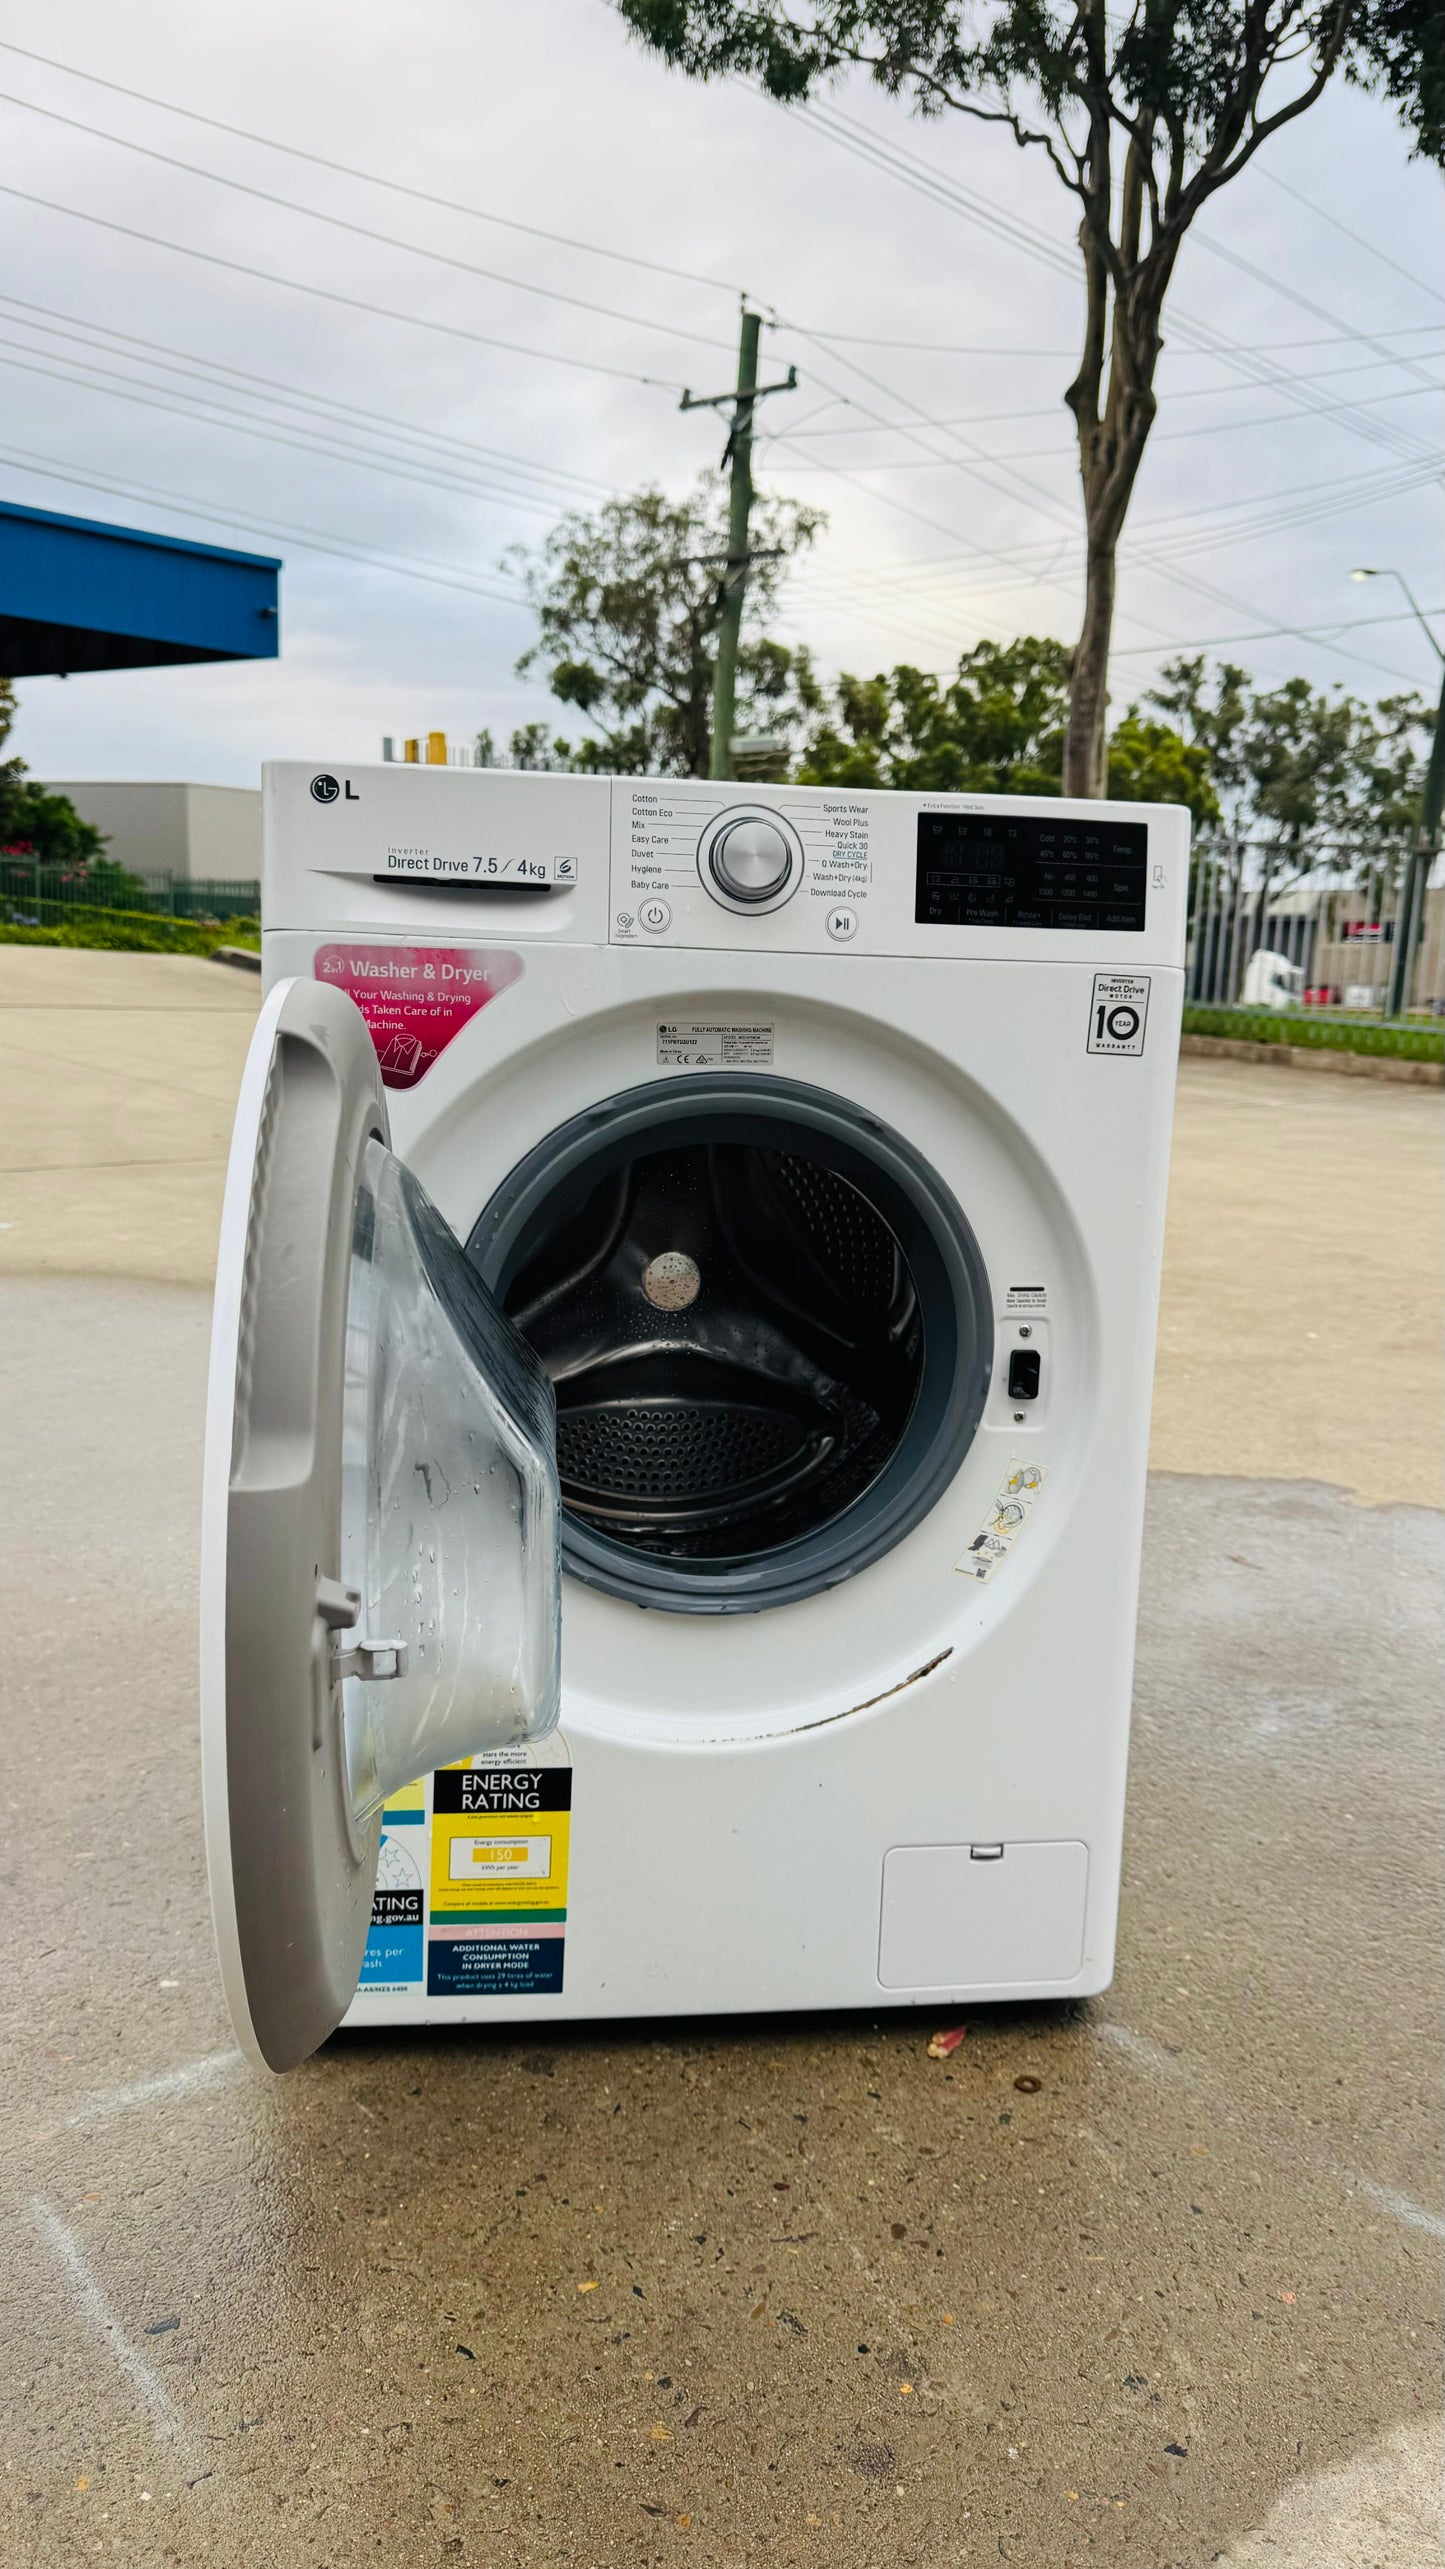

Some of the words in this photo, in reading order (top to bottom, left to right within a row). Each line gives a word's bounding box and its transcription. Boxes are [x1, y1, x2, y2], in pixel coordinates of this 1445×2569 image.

[632, 794, 658, 803] Cotton
[632, 807, 657, 817] Cotton
[659, 809, 673, 817] Eco
[823, 804, 847, 813] Sports
[849, 805, 868, 813] Wear
[632, 821, 645, 829] Mix
[833, 818, 851, 826] Wool
[853, 819, 868, 827] Plus
[825, 830, 848, 839] Heavy
[850, 831, 868, 839] Stain
[631, 835, 650, 844] Easy
[651, 836, 669, 844] Care
[837, 841, 857, 850] Quick
[387, 847, 429, 855] Inverter
[631, 849, 654, 858] Duvet
[833, 850, 846, 858] DRY
[847, 851, 867, 859] CYCLE
[388, 855, 429, 870] Direct
[433, 857, 468, 872] Drive
[473, 857, 498, 874] 7.5
[631, 865, 662, 874] Hygiene
[631, 880, 649, 890] Baby
[651, 881, 669, 889] Care
[811, 888, 846, 897] Download
[847, 890, 867, 899] Cycle
[930, 907, 942, 916] Dry
[966, 908, 978, 917] Pre
[979, 909, 999, 917] Wash
[350, 960, 418, 978] Washer
[423, 964, 436, 979] &
[441, 964, 490, 984] Dryer
[1098, 984, 1122, 992] Direct
[1124, 985, 1145, 994] Drive
[353, 988, 378, 1000] Your
[380, 990, 425, 1003] Washing
[427, 992, 435, 1001] &
[438, 992, 471, 1005] Drying
[371, 1004, 401, 1015] Taken
[403, 1005, 427, 1016] Care
[430, 1007, 442, 1016] of
[444, 1007, 452, 1016] in
[1096, 1005, 1139, 1040] 10
[481, 1758, 501, 1766] energy
[503, 1757, 527, 1765] efficient
[462, 1773, 542, 1791] ENERGY
[462, 1793, 540, 1810] RATING
[474, 1839, 493, 1847] Energy
[494, 1838, 529, 1846] consumption
[490, 1849, 512, 1860] 150
[465, 1928, 528, 1938] ATTENTION
[385, 1948, 404, 1958] per
[463, 1953, 529, 1961] CONSUMPTION
[474, 1962, 501, 1970] DRYER
[453, 1973, 479, 1981] product
[476, 1982, 497, 1990] drying
